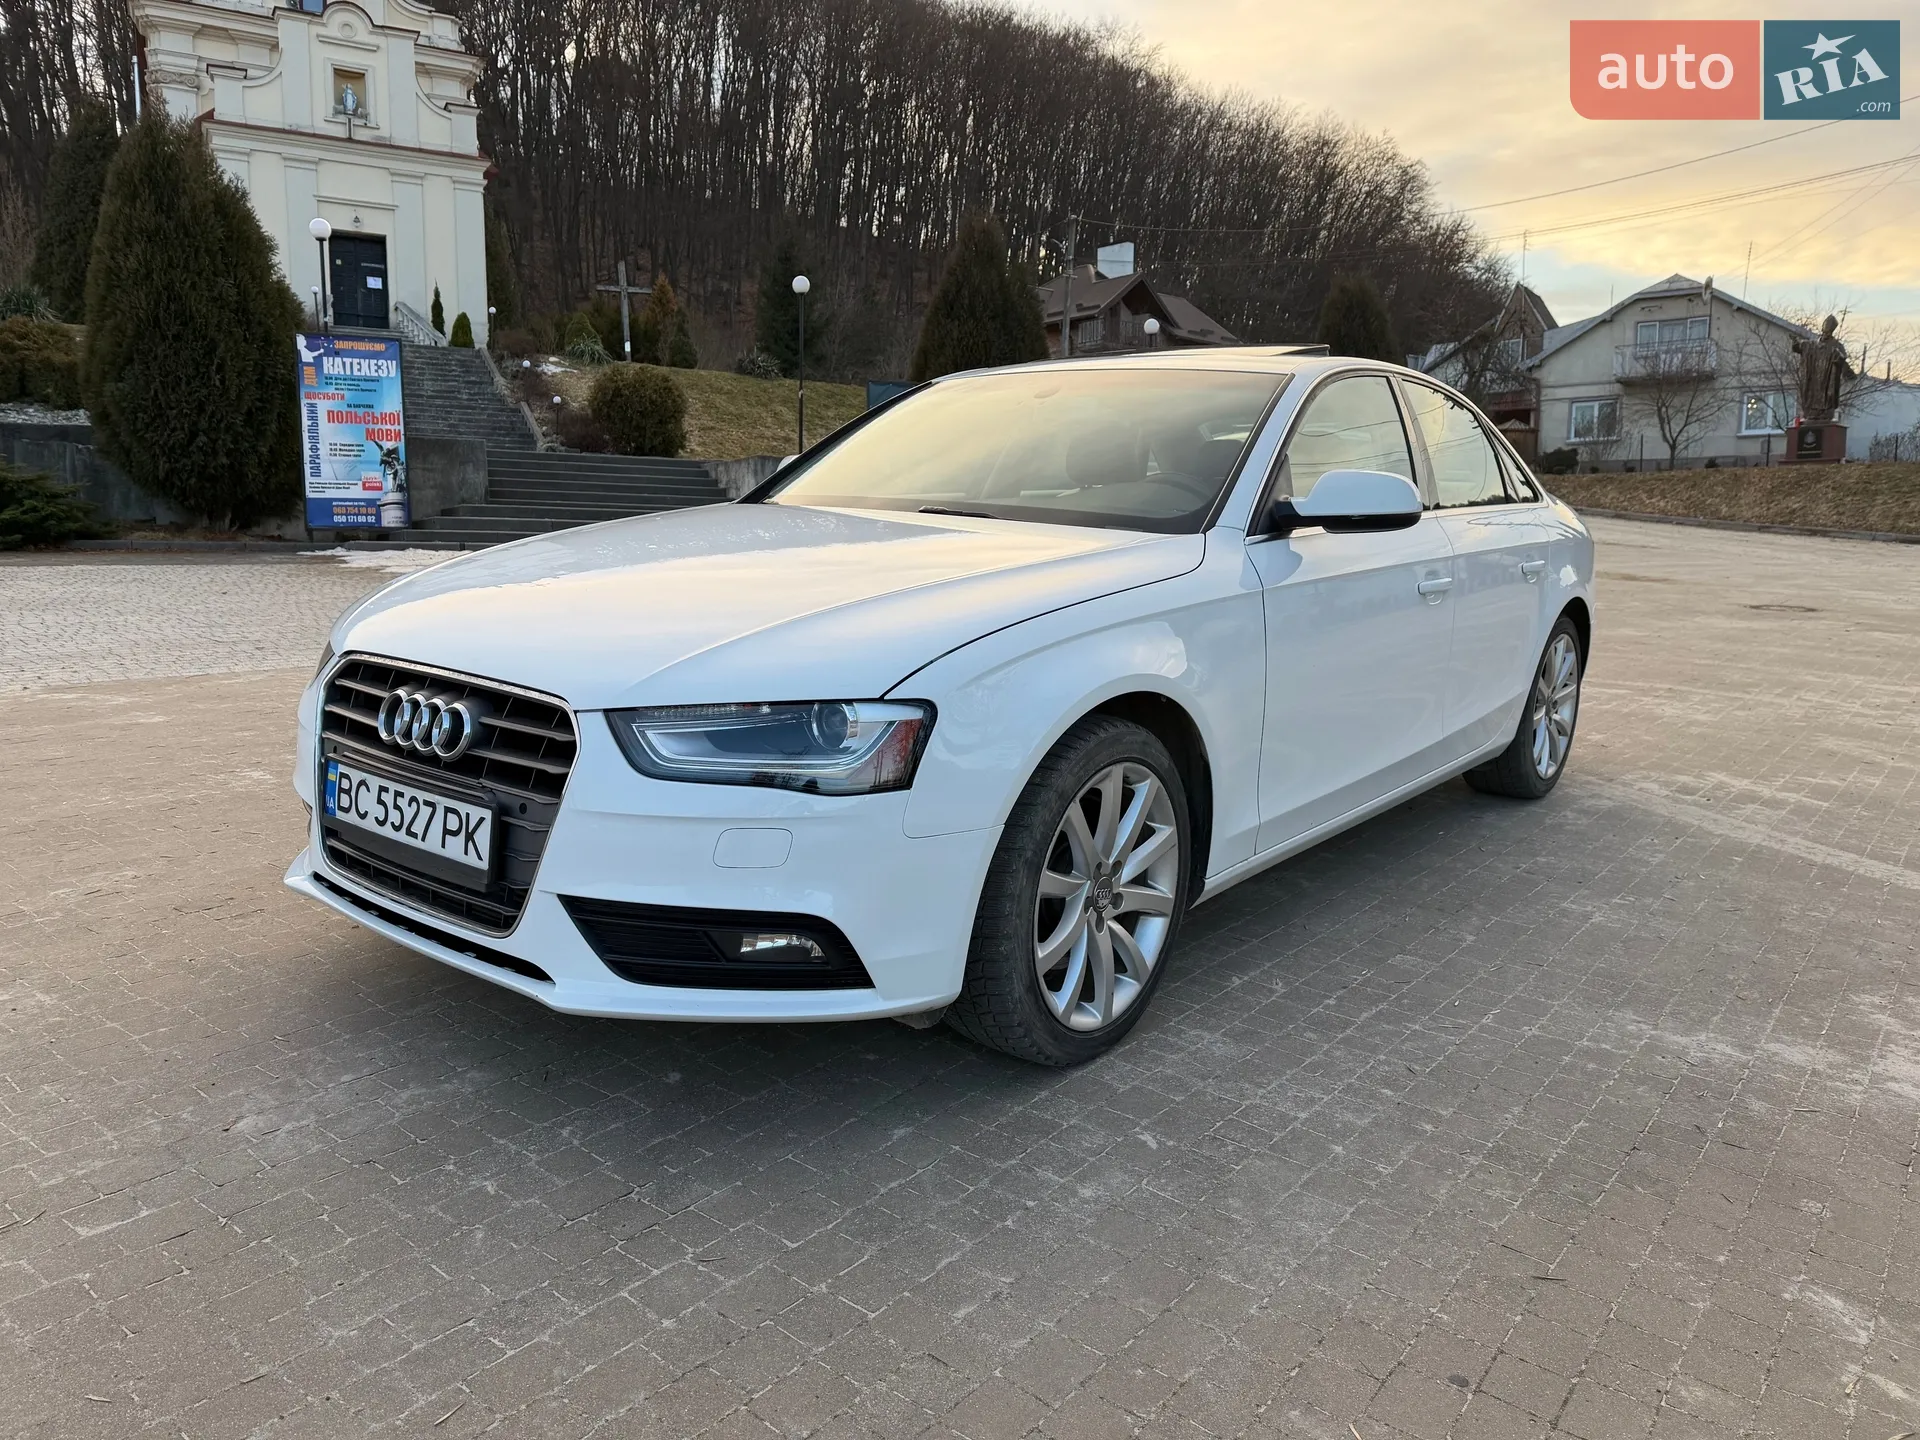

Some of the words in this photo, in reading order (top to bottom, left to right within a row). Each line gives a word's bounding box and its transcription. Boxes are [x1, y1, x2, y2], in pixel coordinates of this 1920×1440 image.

[334, 340, 385, 351] ЗАПРОШУЄМО
[323, 357, 396, 377] КАТЕХЕЗУ
[303, 366, 318, 387] ДІМ
[304, 392, 344, 400] ЩОСУБОТИ
[327, 410, 400, 426] ПОЛЬСЬКОЇ
[304, 402, 321, 478] ПАРАФІЯЛЬНИЙ
[366, 428, 401, 442] МОВИ
[337, 771, 371, 820] BC
[374, 784, 437, 842] 5527
[441, 805, 486, 862] PK
